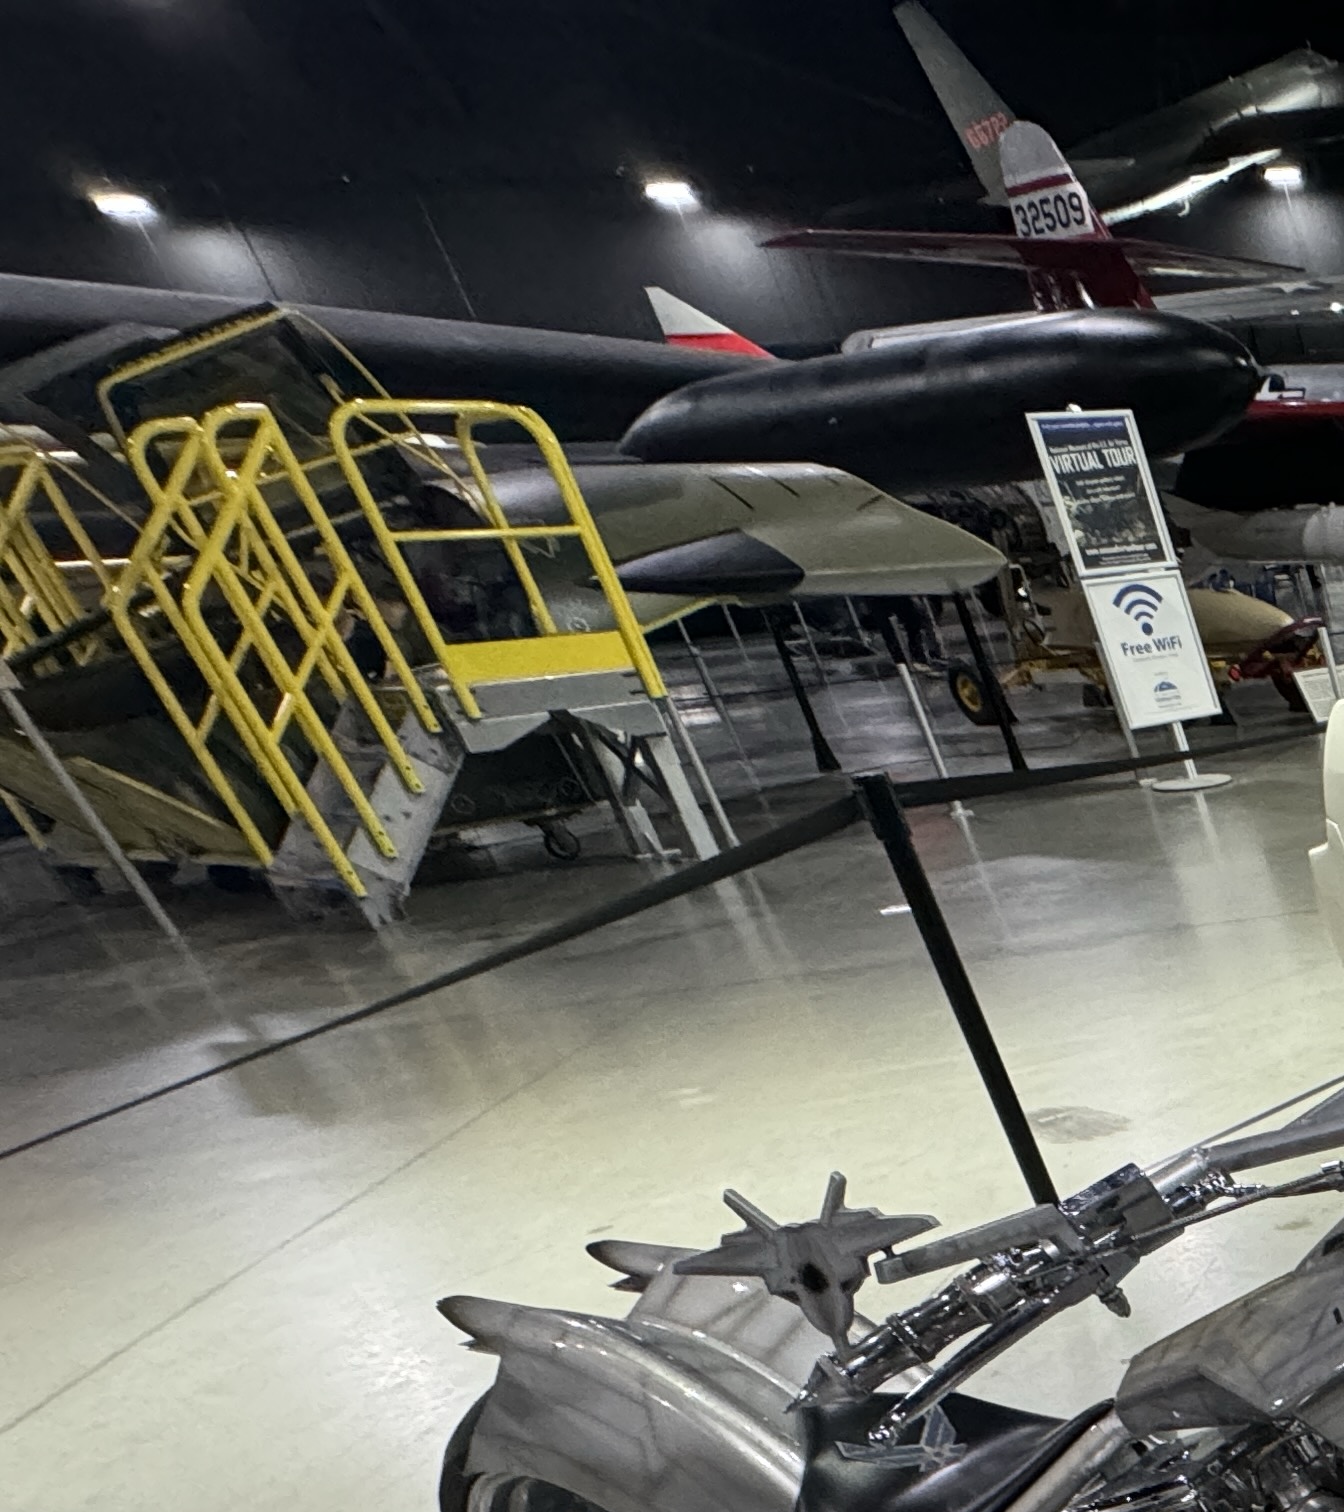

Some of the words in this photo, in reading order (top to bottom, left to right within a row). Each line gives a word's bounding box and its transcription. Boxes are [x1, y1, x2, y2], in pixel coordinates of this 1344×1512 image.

[1014, 191, 1087, 237] 32509
[1048, 450, 1104, 475] VIRTUAL
[1101, 446, 1138, 468] TOUR
[1120, 642, 1153, 657] Free
[1152, 635, 1183, 653] WiFi
